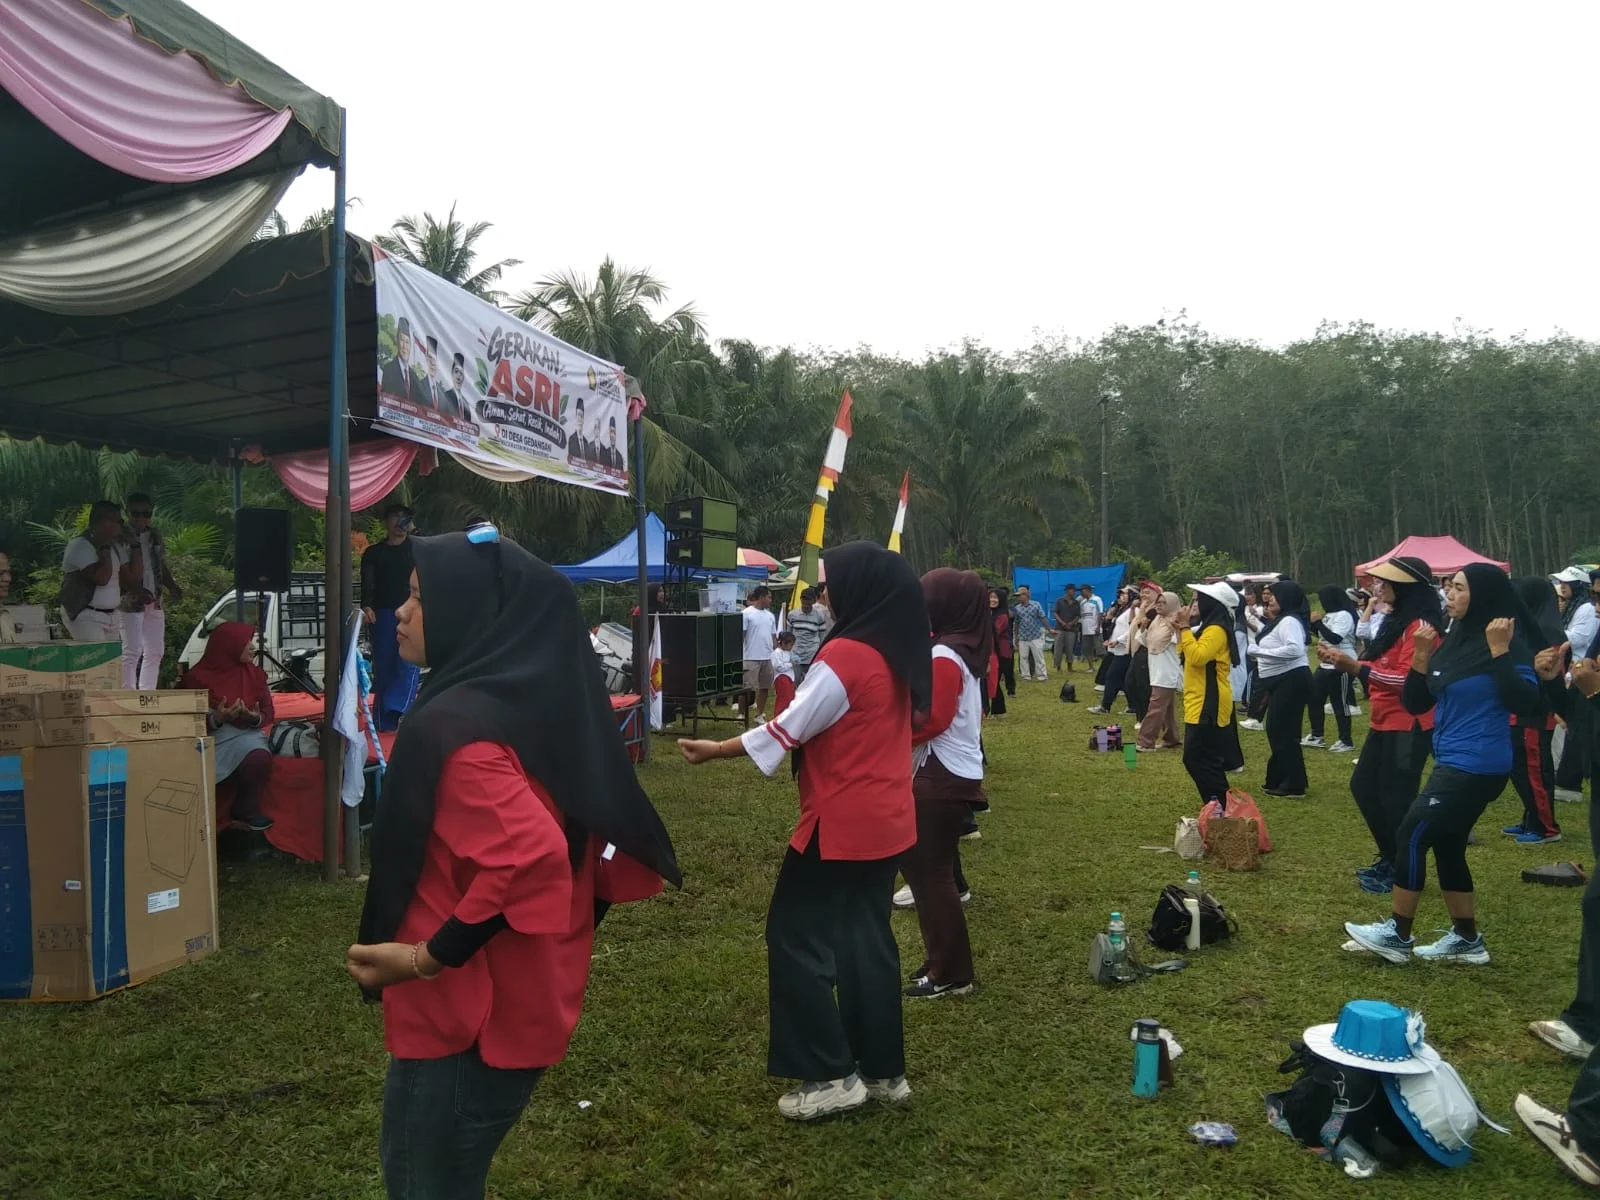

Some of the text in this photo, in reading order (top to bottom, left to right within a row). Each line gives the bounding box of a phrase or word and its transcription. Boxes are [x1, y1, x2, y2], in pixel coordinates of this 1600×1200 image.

[487, 326, 560, 375] GERAKAN
[487, 359, 560, 421] ASRI
[501, 429, 508, 441] DI
[509, 431, 523, 443] DESA
[523, 436, 552, 453] GEDANGAN
